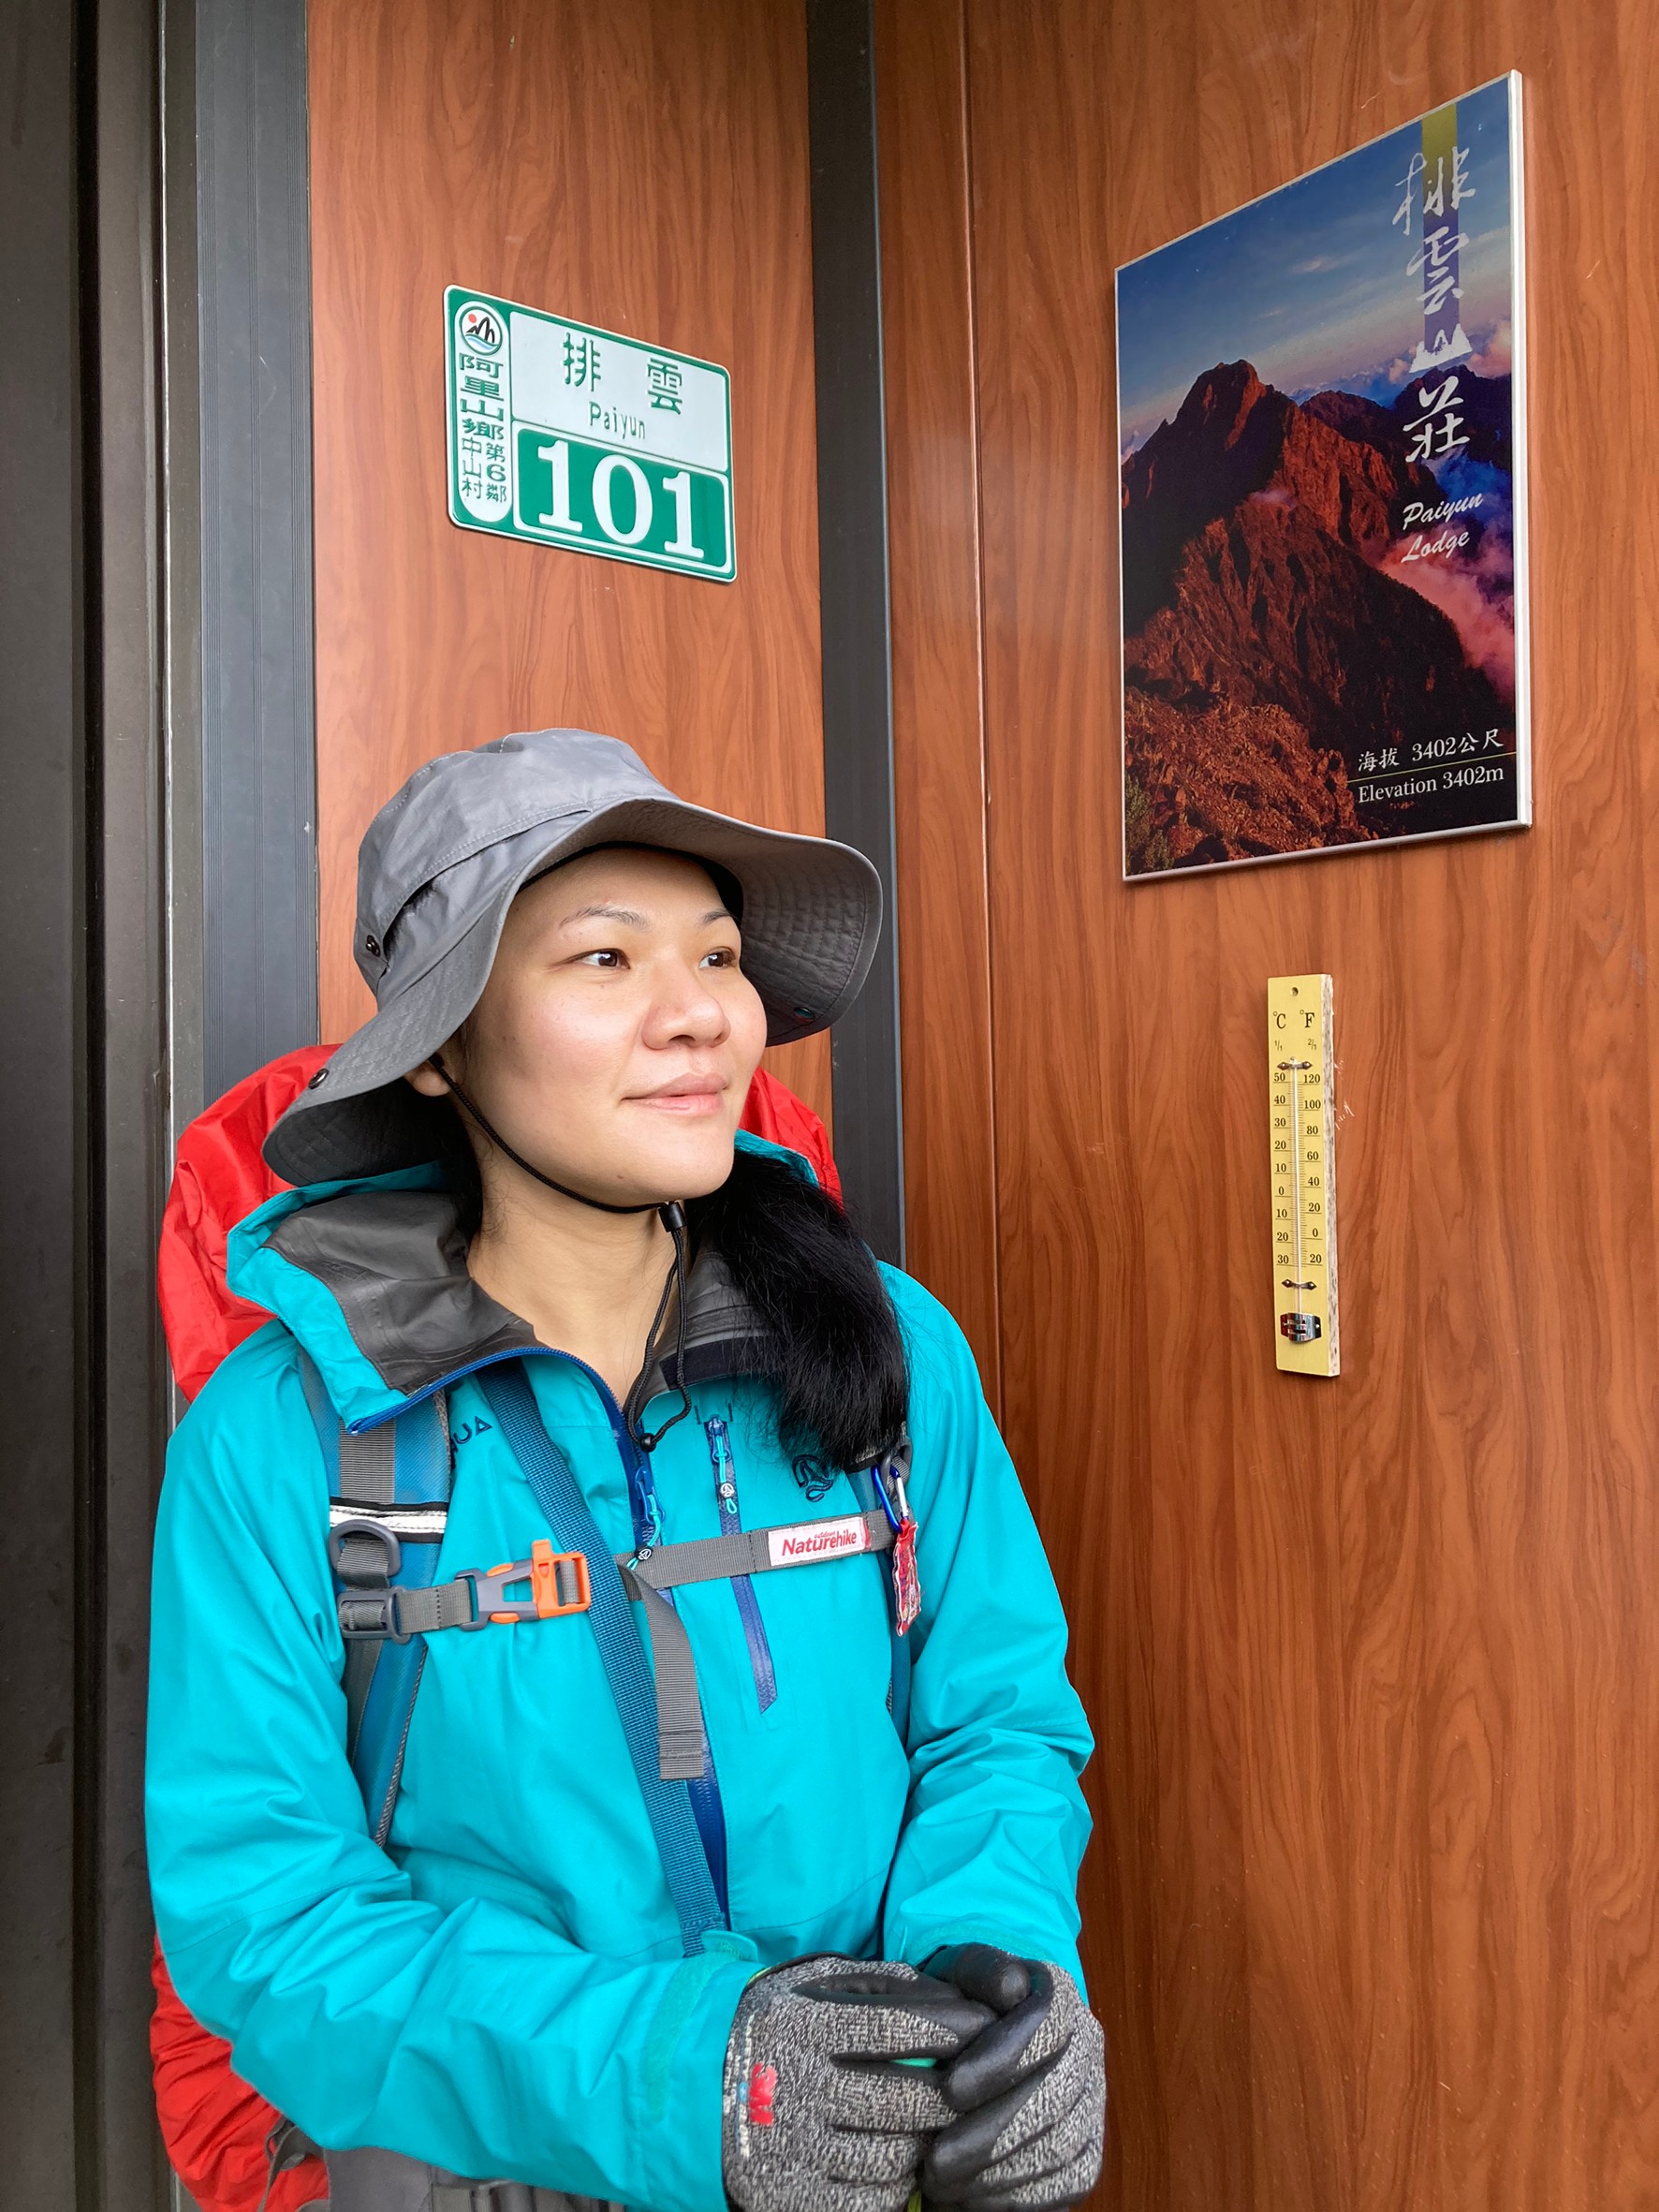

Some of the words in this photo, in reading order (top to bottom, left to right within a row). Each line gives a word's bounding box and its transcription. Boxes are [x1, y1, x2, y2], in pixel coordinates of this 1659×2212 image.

[1392, 146, 1475, 463] 排雲山莊
[563, 332, 683, 415] 排雲
[459, 353, 505, 440] 阿里山鄉
[589, 402, 646, 439] Paiyun
[462, 436, 483, 499] 中山村
[486, 442, 507, 504] 第6鄰
[537, 439, 705, 559] 101
[1403, 492, 1483, 530] Paiyun
[1401, 528, 1471, 563] Lodge
[1358, 748, 1400, 772] 海拔
[1412, 729, 1504, 761] 3402公尺
[1358, 778, 1437, 804] Elevation
[1443, 766, 1504, 789] 3402m
[1273, 1072, 1285, 1082] 50
[1303, 1074, 1320, 1084] 120
[1273, 1095, 1285, 1104] 40
[1304, 1099, 1321, 1109] 100
[1274, 1118, 1286, 1128] 30
[1307, 1126, 1318, 1135] 80
[1274, 1141, 1286, 1150] 20
[1307, 1151, 1319, 1160] 60
[1275, 1163, 1286, 1172] 10
[1308, 1176, 1320, 1187] 40
[1278, 1187, 1285, 1196] 0
[1308, 1202, 1320, 1213] 20
[1276, 1209, 1287, 1218] 10
[1277, 1231, 1288, 1242] 20
[1313, 1228, 1319, 1238] 0
[1277, 1255, 1289, 1264] 30
[1310, 1254, 1322, 1264] 20
[781, 1530, 857, 1556] Naturehike
[749, 2062, 778, 2125] 3M
